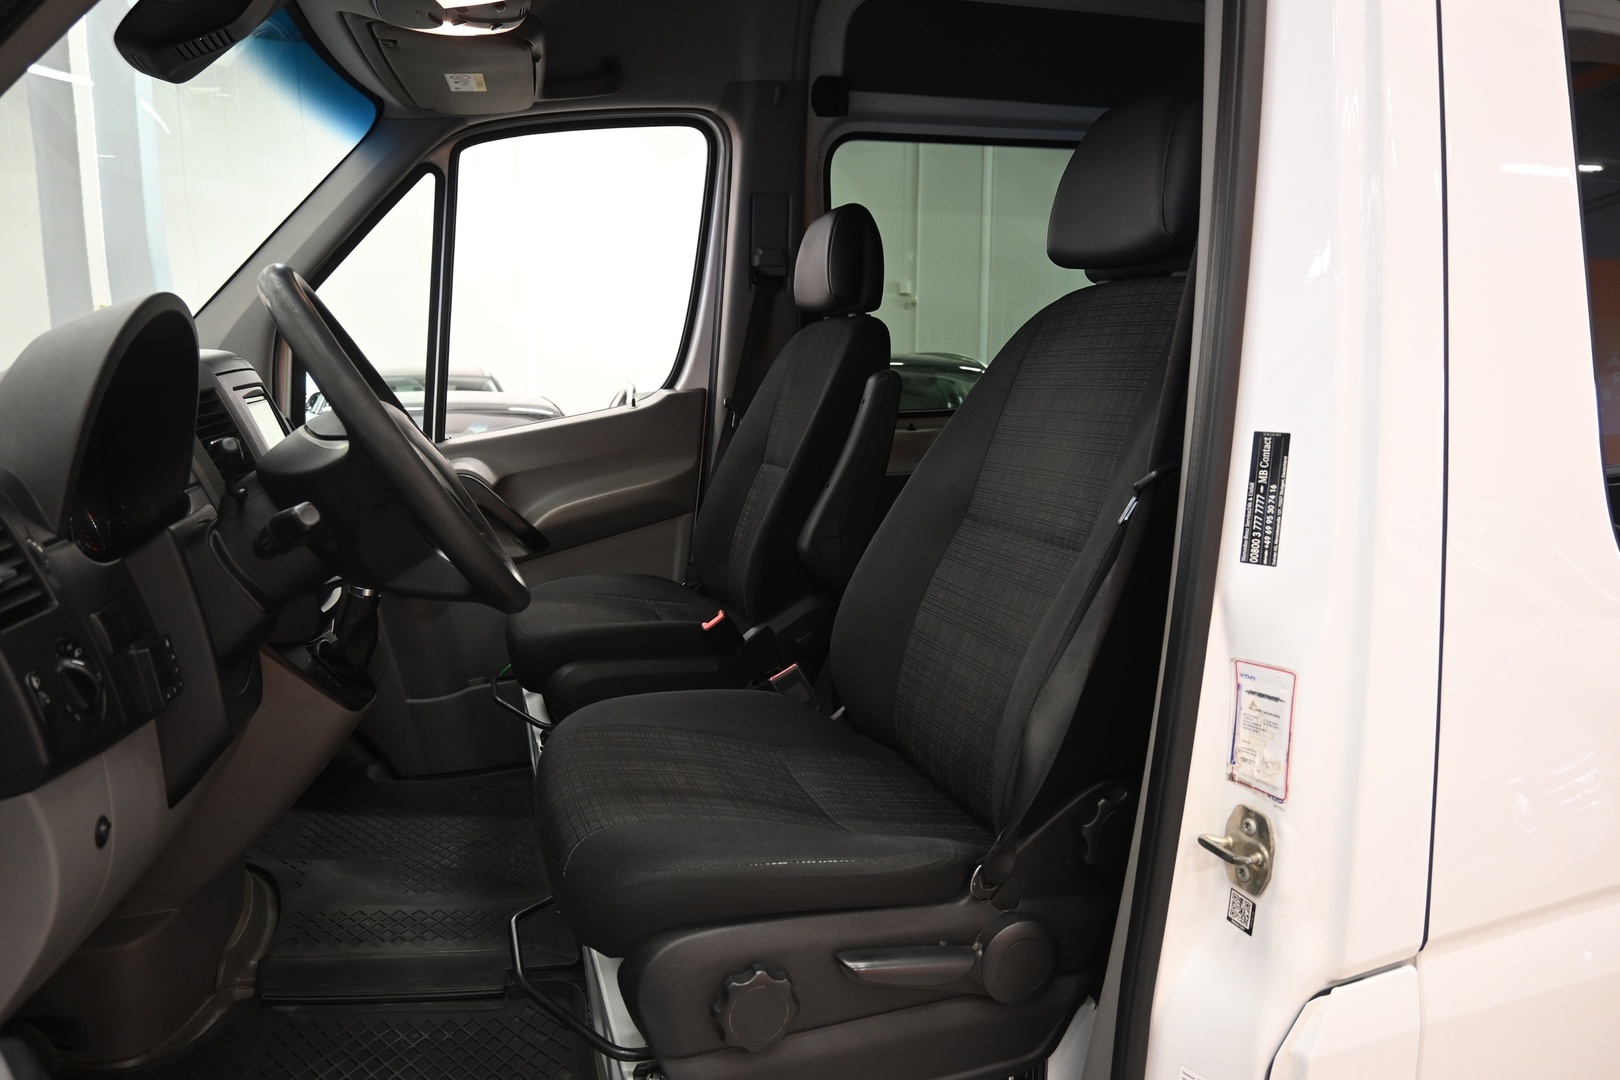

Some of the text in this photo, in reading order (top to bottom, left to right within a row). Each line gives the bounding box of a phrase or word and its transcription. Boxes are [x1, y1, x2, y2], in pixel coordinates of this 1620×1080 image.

[1259, 437, 1272, 468] Contact
[1257, 470, 1268, 484] MB
[1269, 485, 1277, 493] 16
[1254, 494, 1265, 514] 7777
[1268, 496, 1276, 504] 74
[1267, 506, 1275, 515] 30
[1252, 516, 1263, 531] 777
[1266, 516, 1273, 524] 95
[1264, 526, 1272, 535] 69
[1263, 537, 1271, 549] +49
[1249, 539, 1261, 563] 00800
